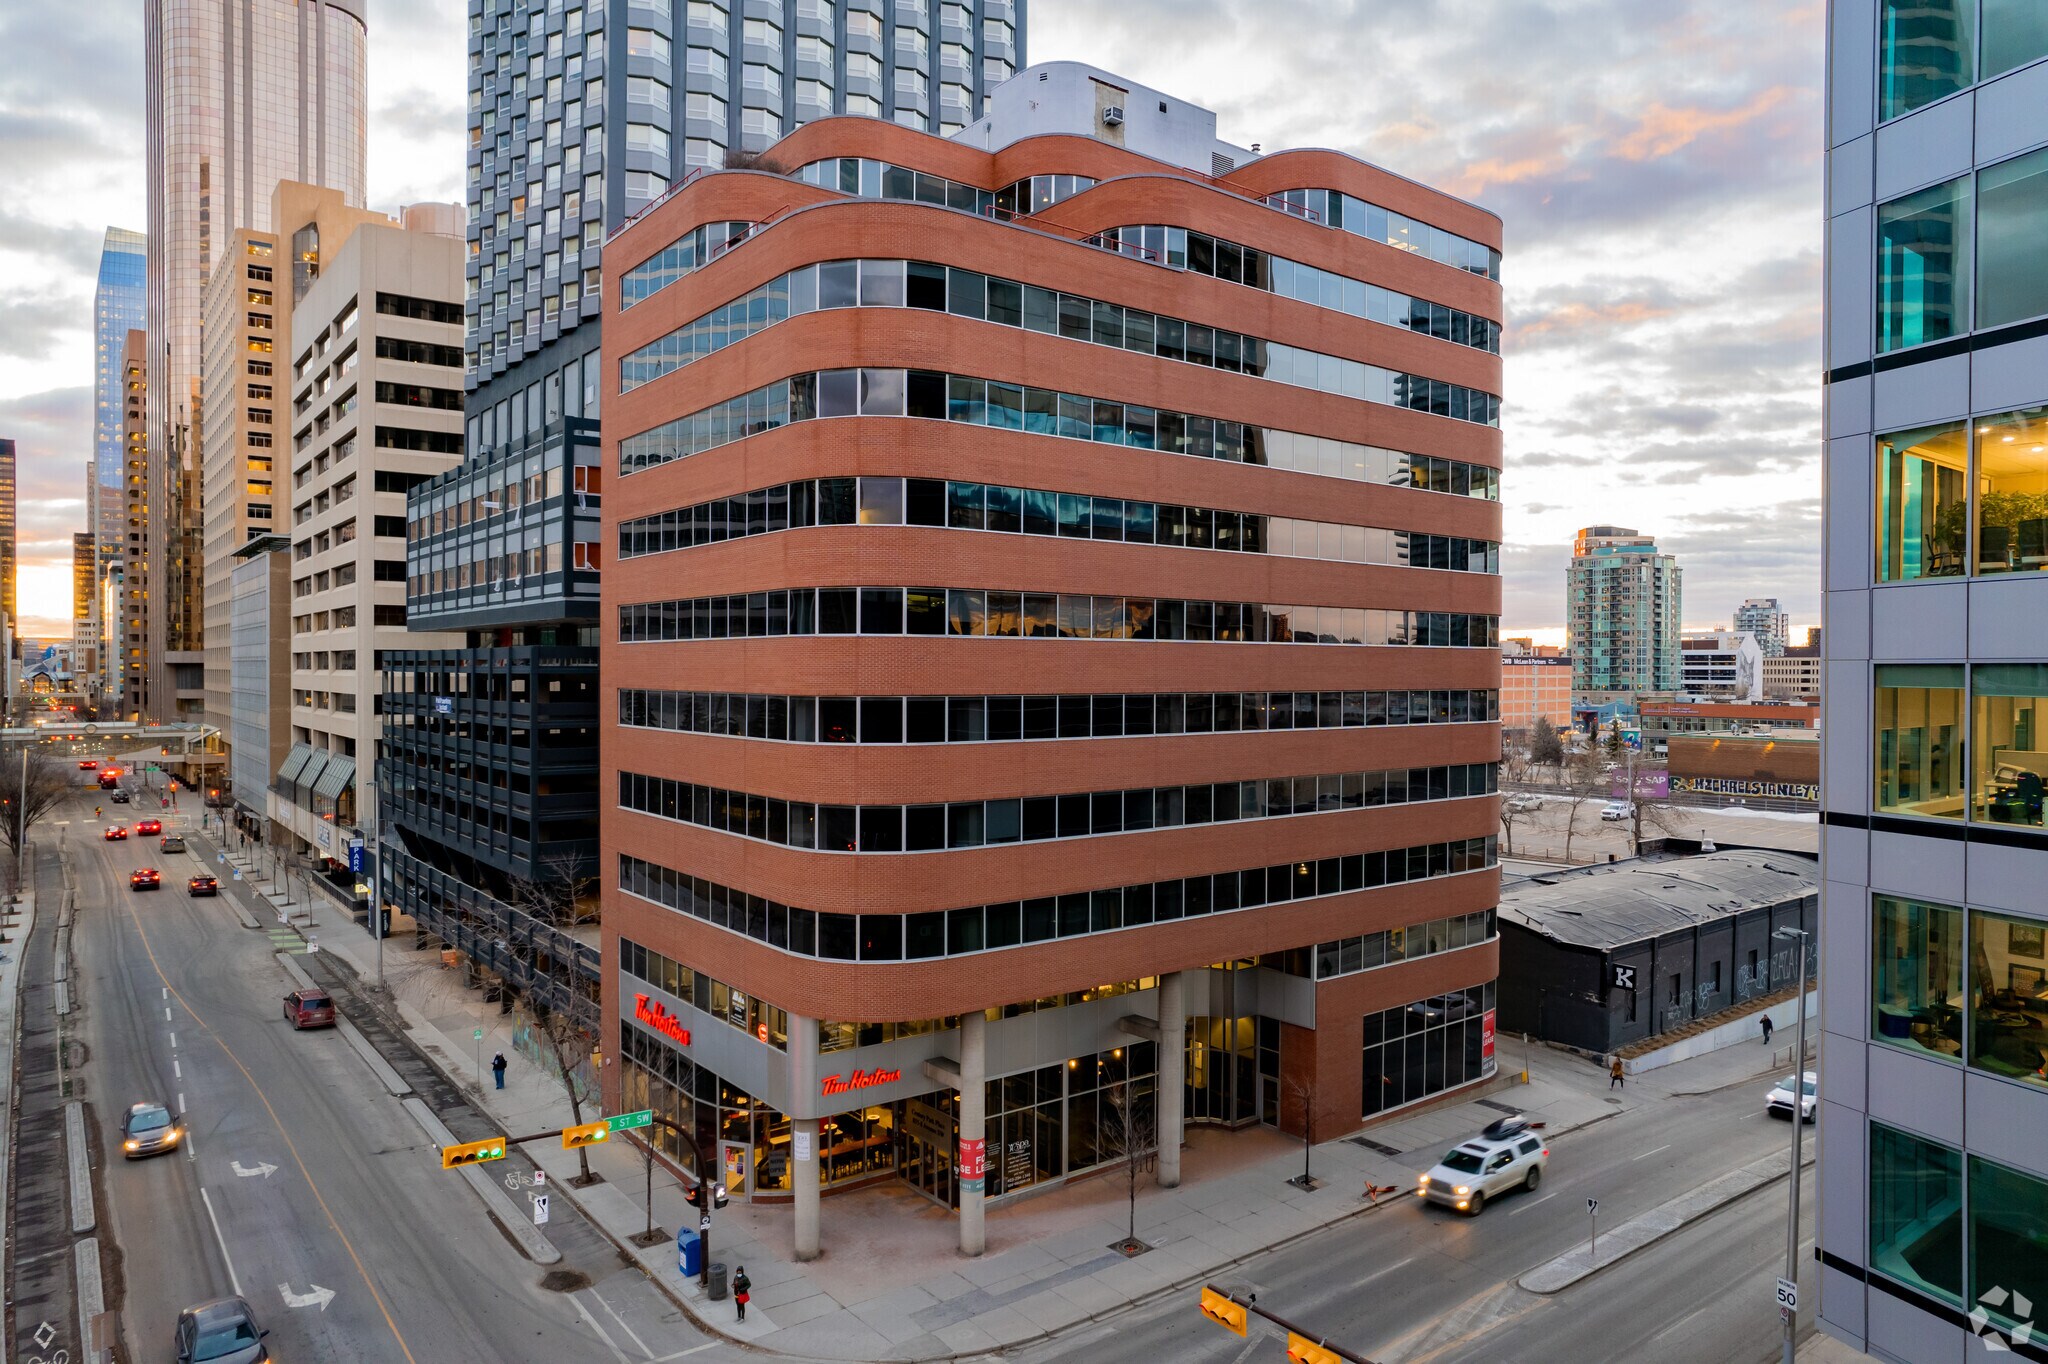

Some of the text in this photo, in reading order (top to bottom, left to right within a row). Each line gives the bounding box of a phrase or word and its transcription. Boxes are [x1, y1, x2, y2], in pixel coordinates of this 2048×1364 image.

[1645, 776, 1666, 784] SAP
[1616, 967, 1633, 988] K
[634, 993, 653, 1027] Tim
[651, 1001, 691, 1046] Hortons
[822, 1067, 901, 1097] Tim Hortons
[620, 1117, 630, 1127] ST
[637, 1113, 649, 1123] SW
[1778, 1280, 1796, 1290] MAXIMUM
[1778, 1288, 1796, 1306] 50
